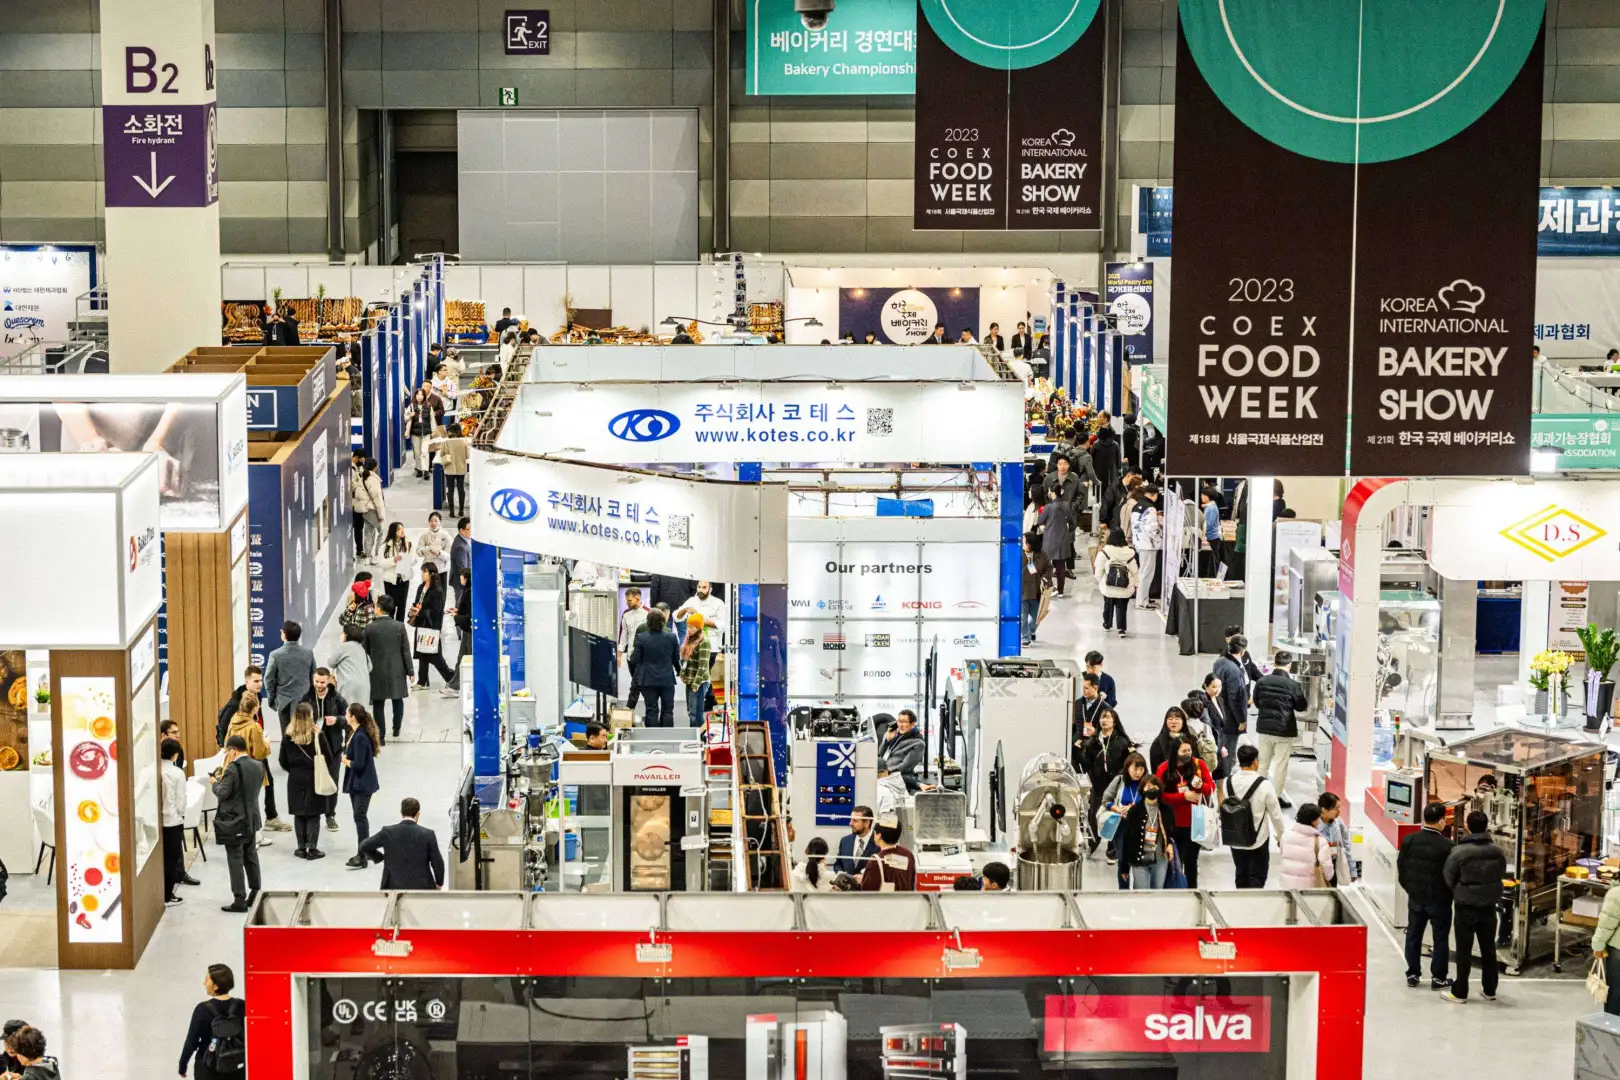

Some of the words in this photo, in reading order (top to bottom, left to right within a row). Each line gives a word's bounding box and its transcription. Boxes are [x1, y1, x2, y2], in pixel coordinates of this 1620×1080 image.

[537, 21, 548, 38] 2
[528, 40, 548, 49] EXIT
[770, 30, 848, 53] 베이커리
[125, 46, 179, 94] B2
[784, 63, 829, 77] Bakery
[123, 114, 183, 136] 소화전
[132, 136, 147, 145] Fire
[147, 136, 176, 146] hydrant
[944, 128, 979, 142] 2023
[1021, 138, 1052, 147] KOREA
[930, 148, 991, 159] COEX
[1021, 148, 1088, 158] INTERNATIONAL
[929, 162, 993, 180] FOOD
[1021, 163, 1088, 180] BAKERY
[929, 183, 993, 202] WEEK
[1021, 185, 1081, 202] SHOW
[1228, 277, 1295, 302] 2023
[1380, 297, 1438, 313] KOREA
[1199, 315, 1317, 337] COEX
[1379, 318, 1508, 333] INTERNATIONAL
[1198, 344, 1321, 378] FOOD
[1378, 346, 1509, 377] BAKERY
[1197, 385, 1319, 419] WEEK
[1378, 388, 1494, 421] SHOW
[694, 403, 775, 423] 주식회사
[695, 428, 856, 443] www.kotes.co.kr
[1188, 434, 1220, 445] 제18회
[1226, 433, 1324, 446] 서울국제식품산업전
[1398, 431, 1424, 446] 한국
[1426, 432, 1451, 446] 국제
[1453, 431, 1516, 446] 베이커리쇼
[547, 490, 602, 517] 주식회사
[547, 515, 661, 547] www.kotes.co.kr
[1544, 523, 1580, 542] D.S
[825, 561, 856, 573] Our
[861, 562, 933, 576] partners
[362, 1001, 387, 1021] CE
[1144, 1005, 1252, 1040] salva
